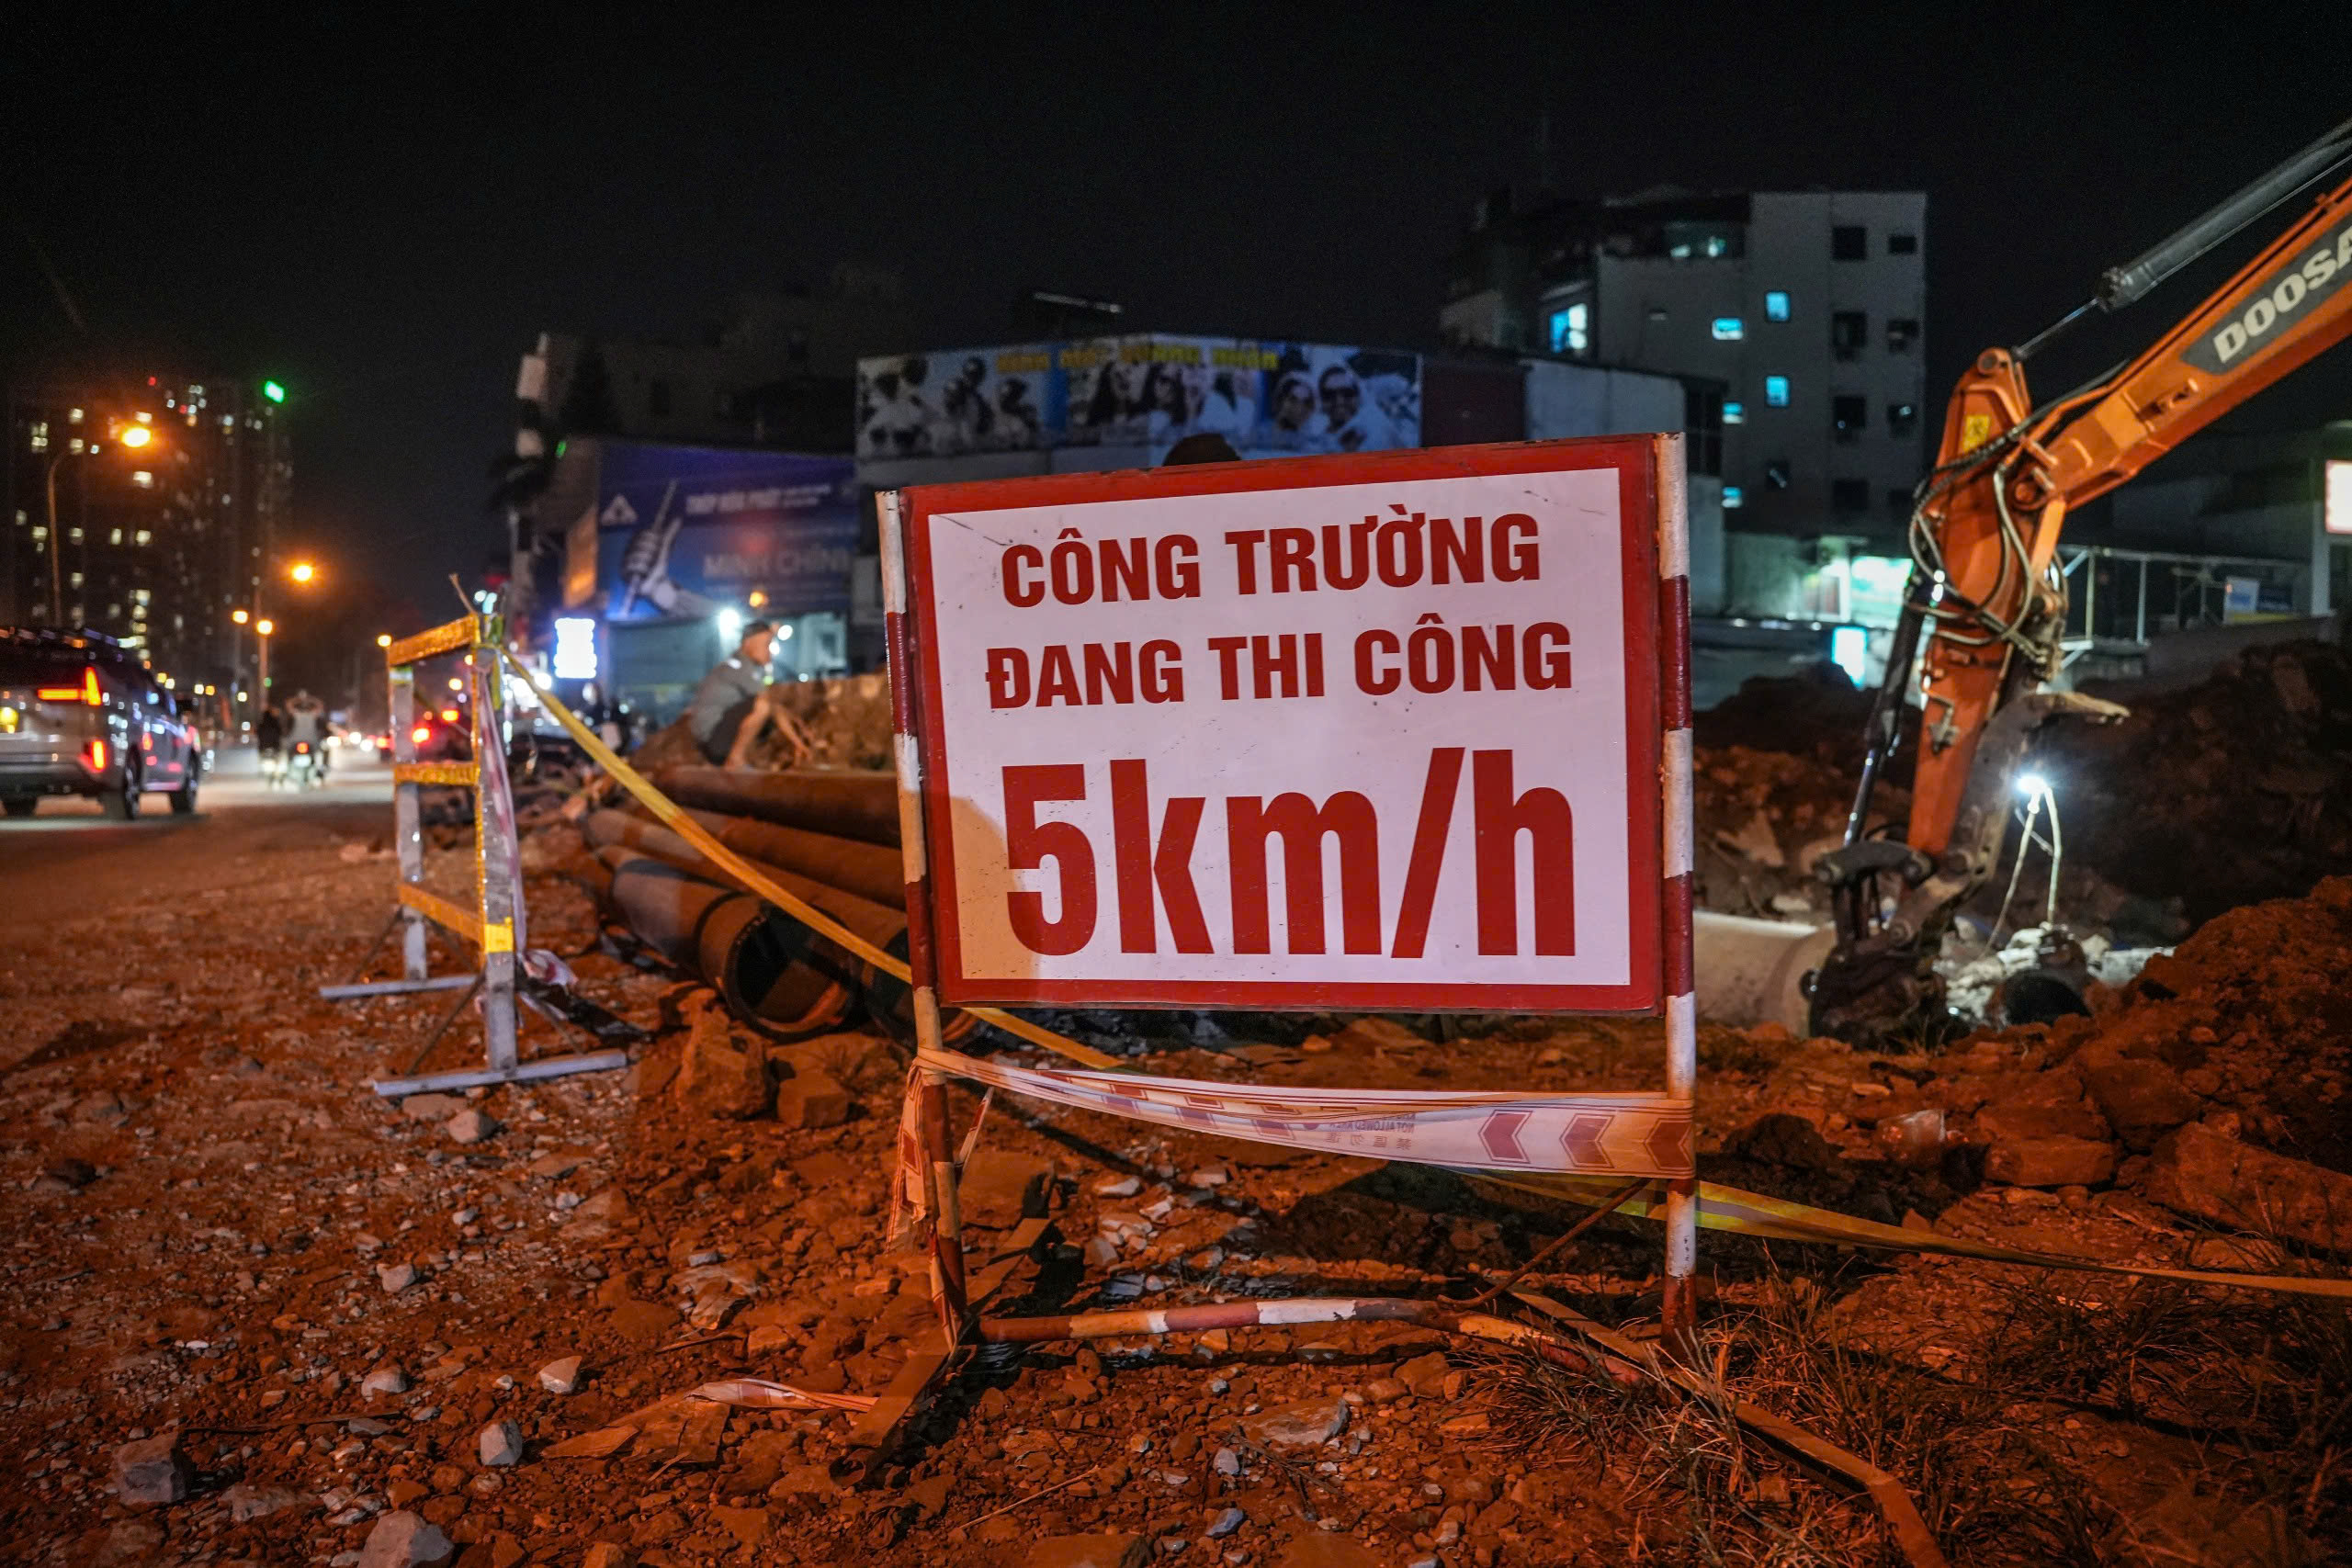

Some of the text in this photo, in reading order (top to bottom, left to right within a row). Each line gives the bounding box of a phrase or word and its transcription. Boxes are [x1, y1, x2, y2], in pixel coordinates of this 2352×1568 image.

[1001, 503, 1541, 608] CÔNG TRƯỜNG
[985, 613, 1572, 709] ĐANG THI CÔNG
[1001, 747, 1576, 959] 5km/h
